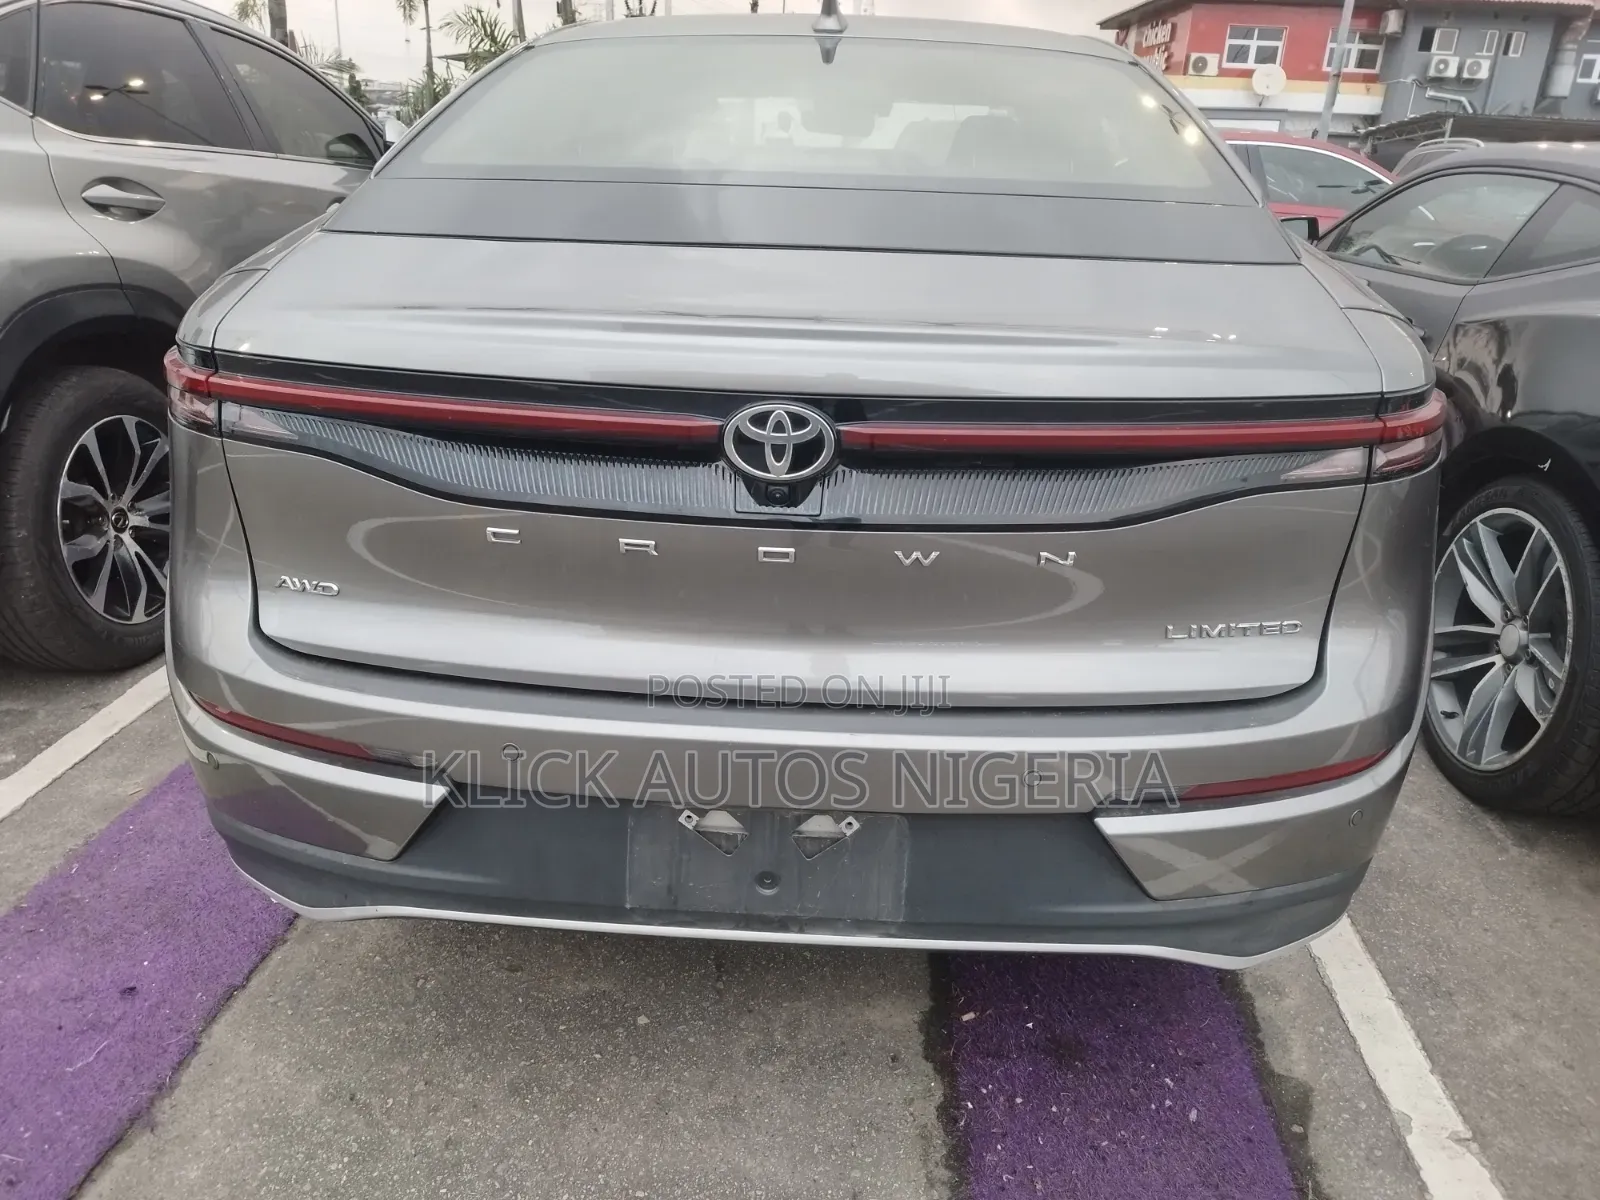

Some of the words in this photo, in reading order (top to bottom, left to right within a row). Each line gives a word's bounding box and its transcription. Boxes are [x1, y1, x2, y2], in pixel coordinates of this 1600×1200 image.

[486, 527, 1077, 567] CROWN
[274, 575, 340, 597] AWD
[1165, 619, 1303, 640] LIMITED
